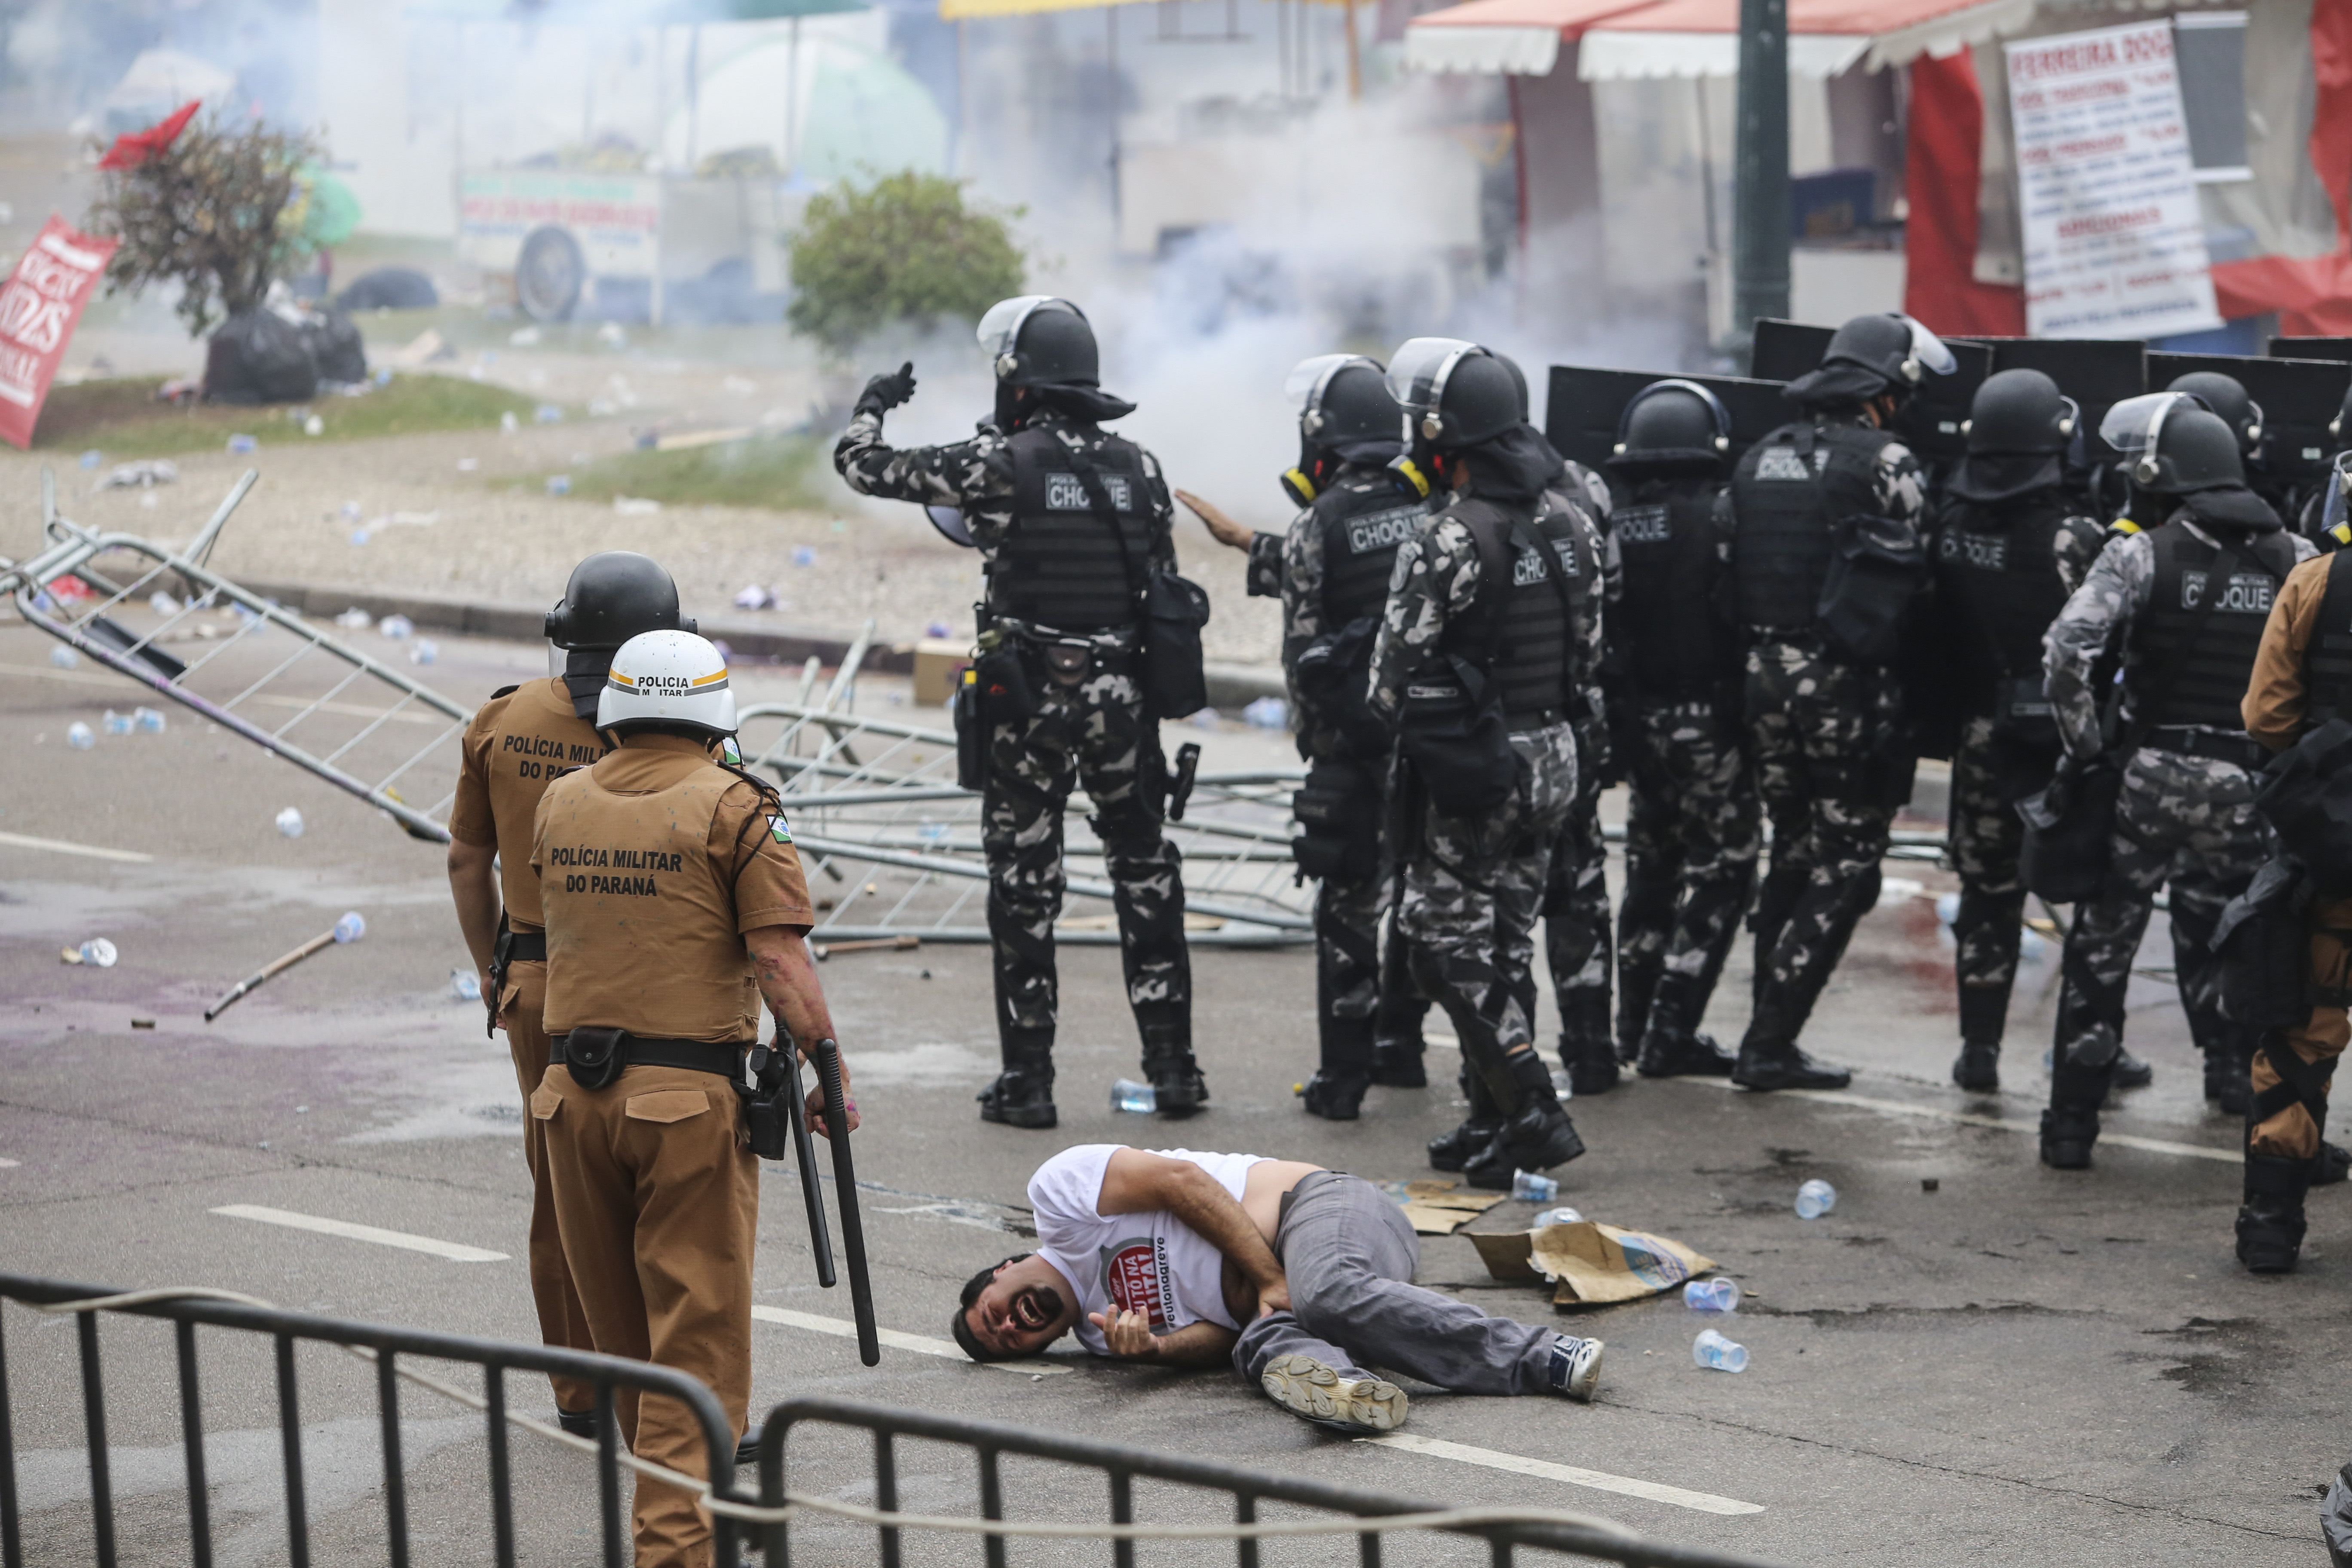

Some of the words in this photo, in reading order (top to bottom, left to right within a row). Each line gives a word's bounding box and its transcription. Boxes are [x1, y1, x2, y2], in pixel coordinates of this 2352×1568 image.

[1050, 485, 1128, 510] CHOE
[1514, 551, 1575, 582] CHOE
[2186, 583, 2270, 610] COQUE
[638, 676, 689, 688] POLICIA
[503, 735, 564, 759] POLÍCIA
[519, 760, 541, 779] DO
[551, 844, 608, 867] POLÍCIA
[612, 850, 682, 873] MILITAR
[566, 875, 586, 893] DO
[591, 874, 657, 897] PARANÁ
[1124, 1255, 1141, 1276] NA
[1157, 1237, 1176, 1328] #eutonagreve
[1133, 1300, 1147, 1315] U
